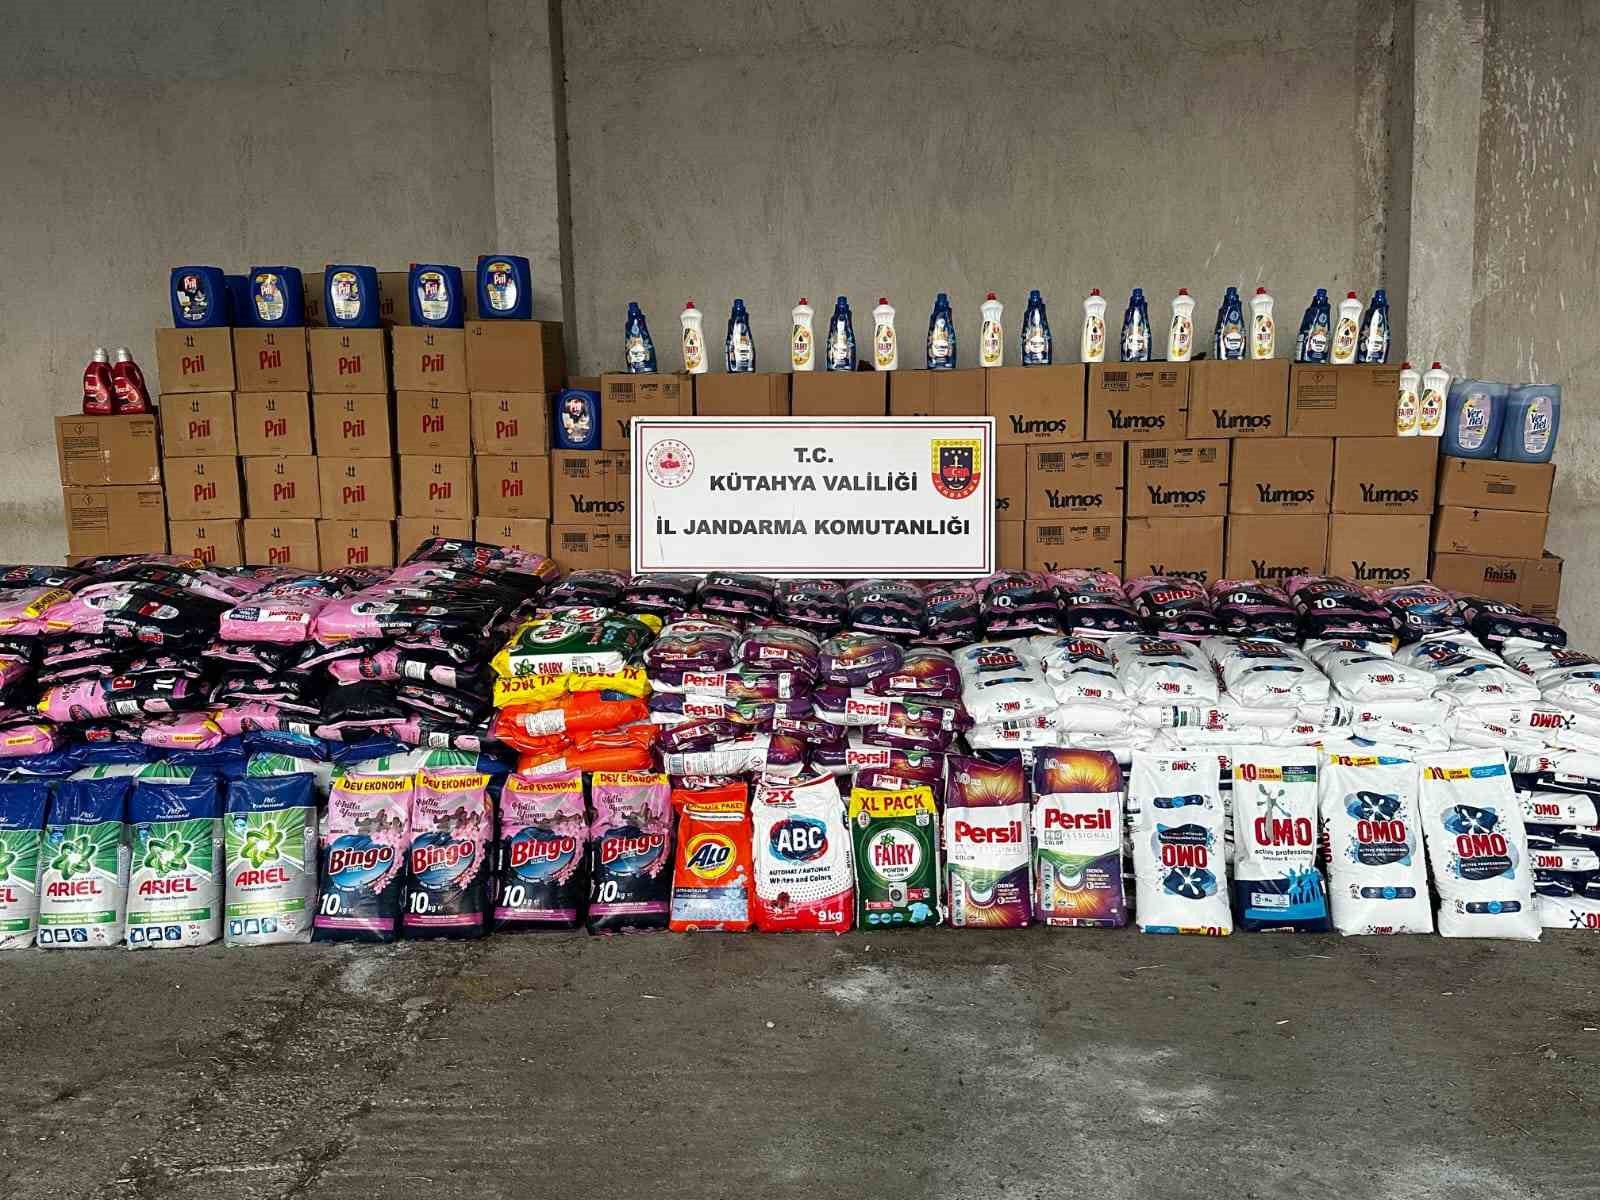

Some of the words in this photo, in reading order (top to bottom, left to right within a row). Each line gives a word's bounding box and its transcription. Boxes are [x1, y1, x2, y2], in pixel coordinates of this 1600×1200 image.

[182, 355, 206, 376] Pril
[259, 351, 282, 370] Pril
[338, 357, 361, 376] Pril
[422, 354, 444, 374] Pril
[1398, 408, 1414, 417] FAIRY
[1422, 407, 1438, 416] FAIRY
[1466, 408, 1482, 418] Ver
[1468, 416, 1483, 426] nel
[1530, 413, 1544, 423] Ver
[189, 420, 210, 440] Pril
[264, 419, 286, 438] Pril
[343, 420, 366, 439] Pril
[422, 415, 444, 434] Pril
[496, 420, 518, 439] Pril
[1533, 419, 1546, 430] nel
[793, 447, 834, 464] T.C.
[501, 479, 524, 498] Pril
[710, 472, 816, 492] KÜTAHYA
[823, 471, 918, 492] VALİLİĞİ
[194, 482, 216, 502] Pril
[273, 482, 296, 501] Pril
[343, 485, 366, 504] Pril
[430, 482, 452, 501] Pril
[656, 516, 677, 536] İL
[684, 519, 808, 536] JANDARMA
[814, 516, 970, 536] KOMUTANLIĞI
[193, 546, 216, 565] Pril
[268, 546, 291, 566] Pril
[347, 546, 368, 566] Pril
[714, 577, 734, 586] 10
[1484, 566, 1518, 580] finish
[993, 596, 1012, 607] 10
[1071, 596, 1091, 605] 10
[1228, 592, 1248, 604] 10
[1315, 598, 1337, 609] 10
[1406, 612, 1422, 624] 10
[538, 662, 564, 674] FAIRY
[684, 674, 724, 687] Persil
[684, 704, 724, 716] Persil
[847, 700, 889, 716] Persil
[847, 750, 889, 764] Persil
[601, 773, 619, 782] DEV
[1240, 764, 1256, 780] 10
[344, 780, 364, 790] DEV
[364, 782, 405, 791] EKONOMİ
[422, 776, 439, 789] DEV
[442, 778, 482, 790] EKONOMİ
[766, 790, 795, 804] 2X
[860, 797, 880, 810] XL
[884, 795, 925, 810] PACK
[1044, 808, 1112, 830] Persil
[1534, 804, 1560, 816] OMO
[778, 826, 822, 852] ABC
[954, 820, 1022, 844] Persil
[1254, 816, 1313, 846] OMO
[1357, 820, 1406, 844] OMO
[511, 837, 576, 867] Bingo
[602, 832, 664, 864] Bingo
[874, 844, 914, 866] FAIRY
[1456, 834, 1507, 858] OMO
[329, 847, 394, 875] Bingo
[412, 842, 475, 874] Bingo
[1162, 844, 1208, 868] OMO
[1537, 855, 1563, 868] OMO
[235, 867, 290, 887] ARIEL
[795, 874, 808, 882] and
[810, 874, 832, 882] Colors
[46, 880, 103, 897] ARIEL
[138, 878, 198, 896] ARIEL
[502, 885, 526, 907] 10
[597, 880, 618, 902] 10
[320, 892, 340, 914] 10
[410, 892, 429, 914] 10
[818, 910, 827, 922] 9
[828, 910, 844, 922] kg
